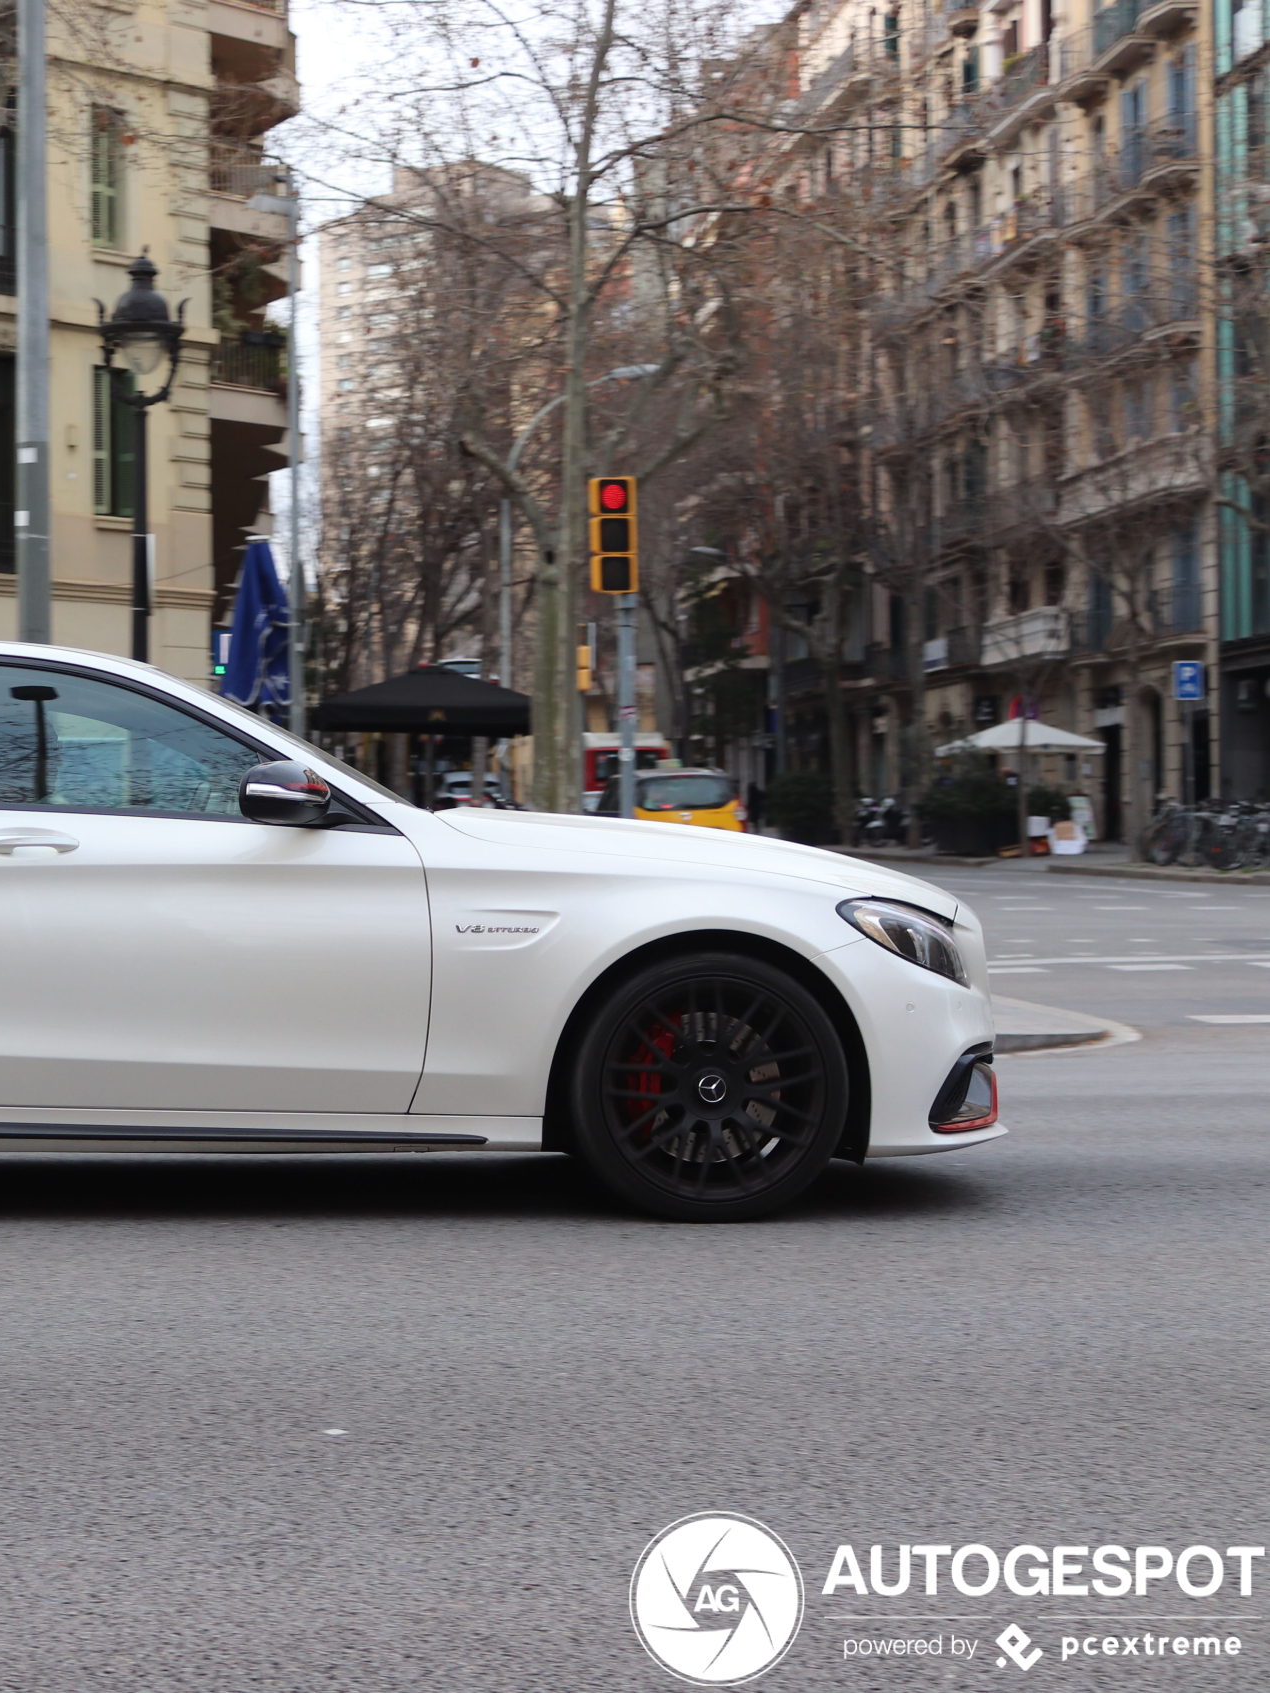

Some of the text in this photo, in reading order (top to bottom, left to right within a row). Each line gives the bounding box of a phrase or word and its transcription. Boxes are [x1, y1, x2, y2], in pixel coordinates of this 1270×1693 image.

[1180, 667, 1196, 681] P
[455, 924, 539, 934] V8 BITURBO
